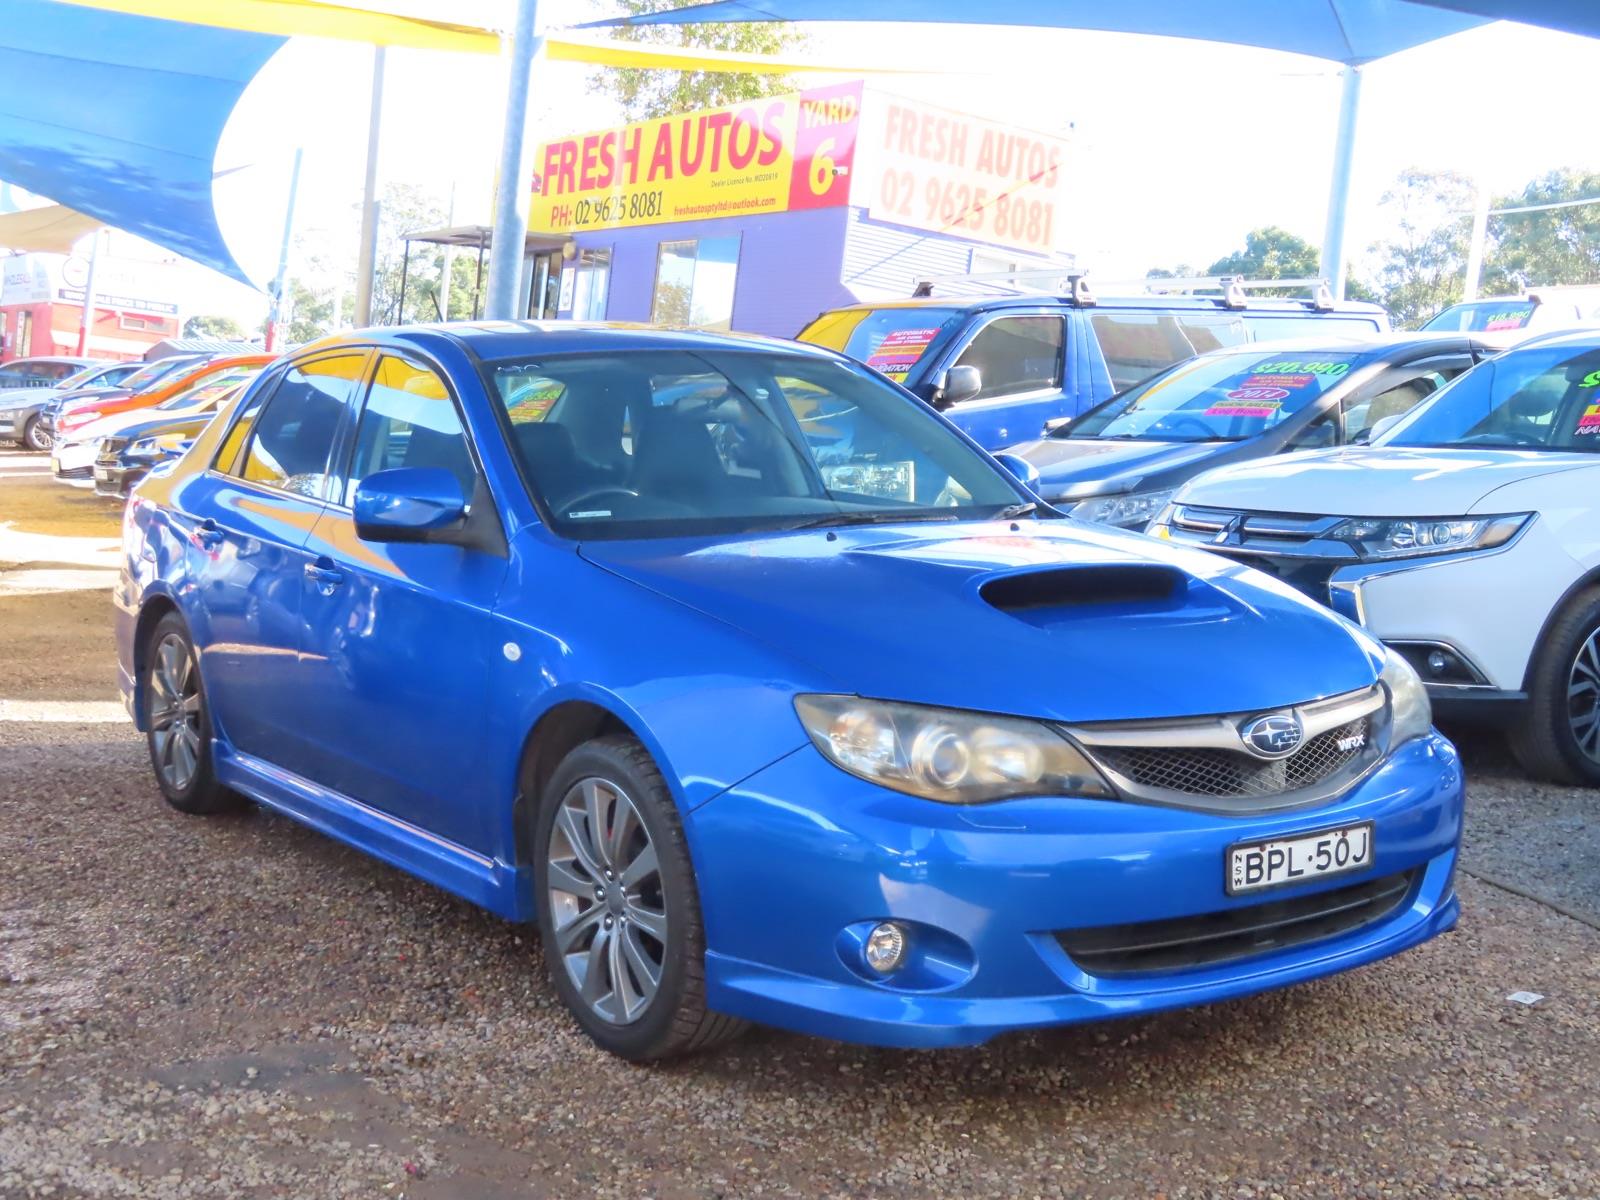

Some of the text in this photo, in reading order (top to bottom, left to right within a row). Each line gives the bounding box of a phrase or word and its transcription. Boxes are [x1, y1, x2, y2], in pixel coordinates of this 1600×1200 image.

[803, 96, 858, 128] YARD
[541, 102, 786, 196] FRESH AUTOS
[809, 137, 836, 196] 6
[884, 104, 1061, 189] FRESH AUTOS
[550, 190, 662, 227] PH: 02 9625 8081
[880, 167, 1054, 246] 02 9625 8081
[1337, 733, 1366, 751] WRX
